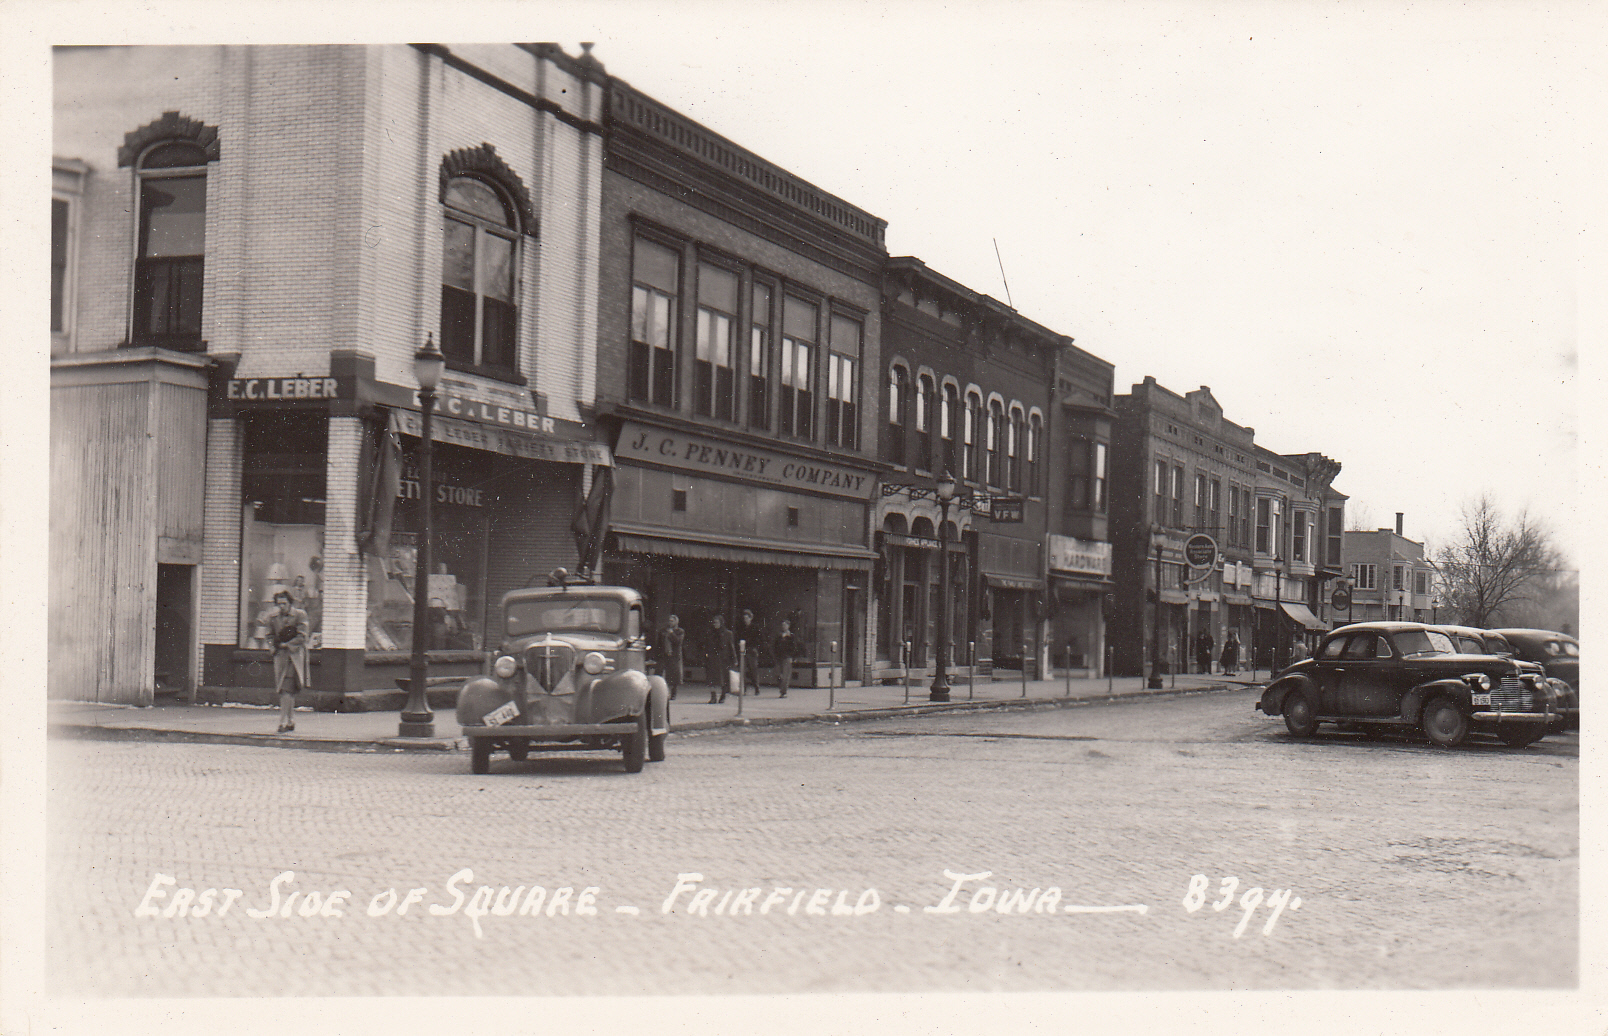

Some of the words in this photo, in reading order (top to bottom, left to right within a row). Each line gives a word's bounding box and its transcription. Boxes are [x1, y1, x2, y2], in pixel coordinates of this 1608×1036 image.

[267, 378, 338, 399] LEBER
[481, 404, 554, 433] LEBER
[632, 432, 649, 451] J.
[659, 438, 677, 456] C.
[685, 442, 771, 474] PENNEY
[782, 463, 866, 491] COMPANY
[437, 485, 483, 507] STORE
[994, 510, 1020, 519] VFW
